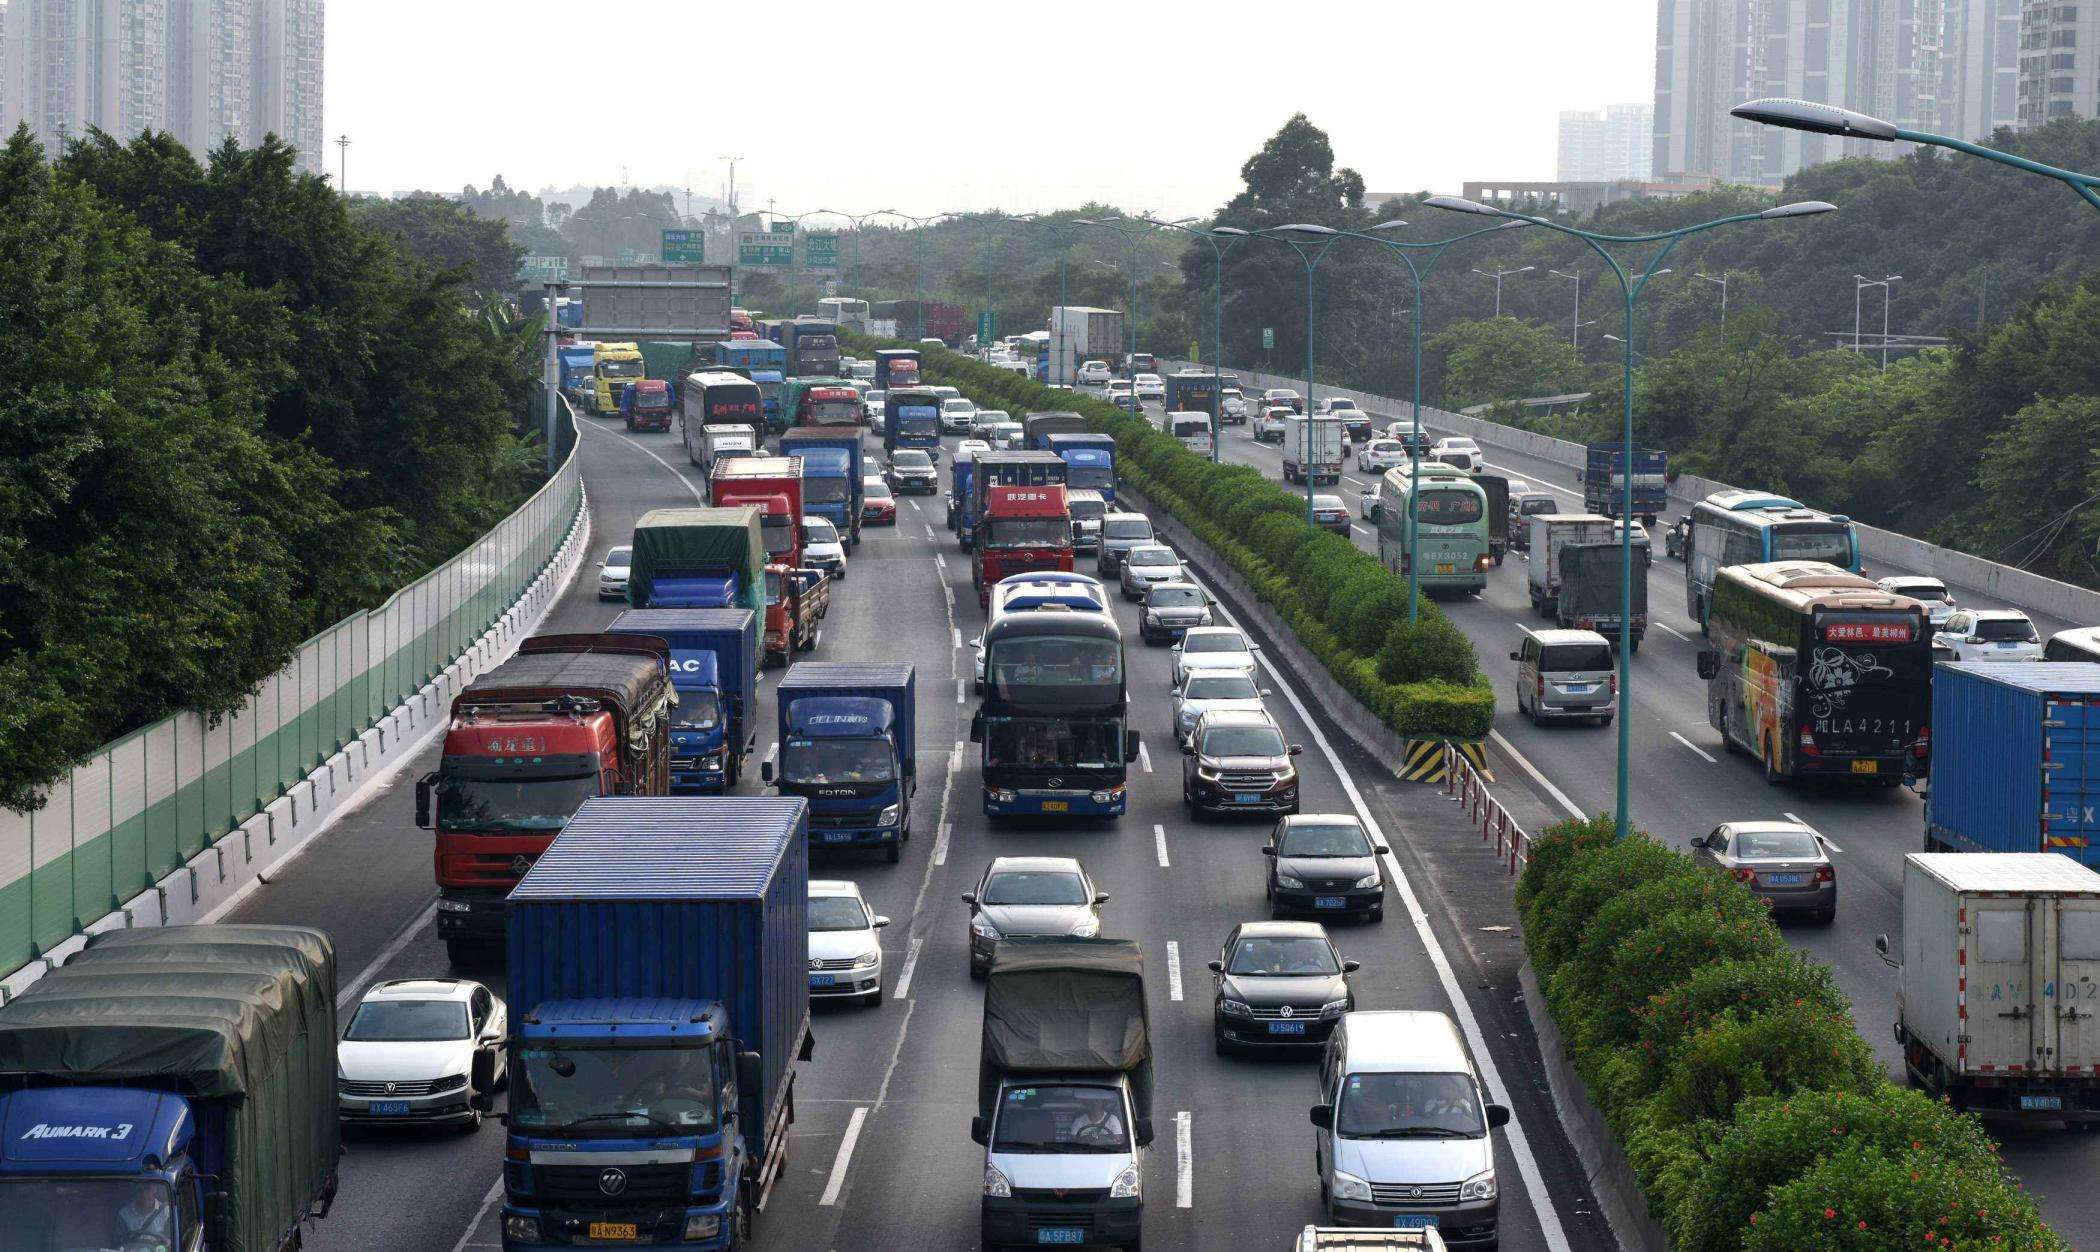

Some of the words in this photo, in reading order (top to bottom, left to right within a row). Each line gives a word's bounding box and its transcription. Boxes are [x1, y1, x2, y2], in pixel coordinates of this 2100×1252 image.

[669, 659, 700, 672] AC
[20, 1123, 113, 1140] AUMARK
[111, 1123, 133, 1140] 3
